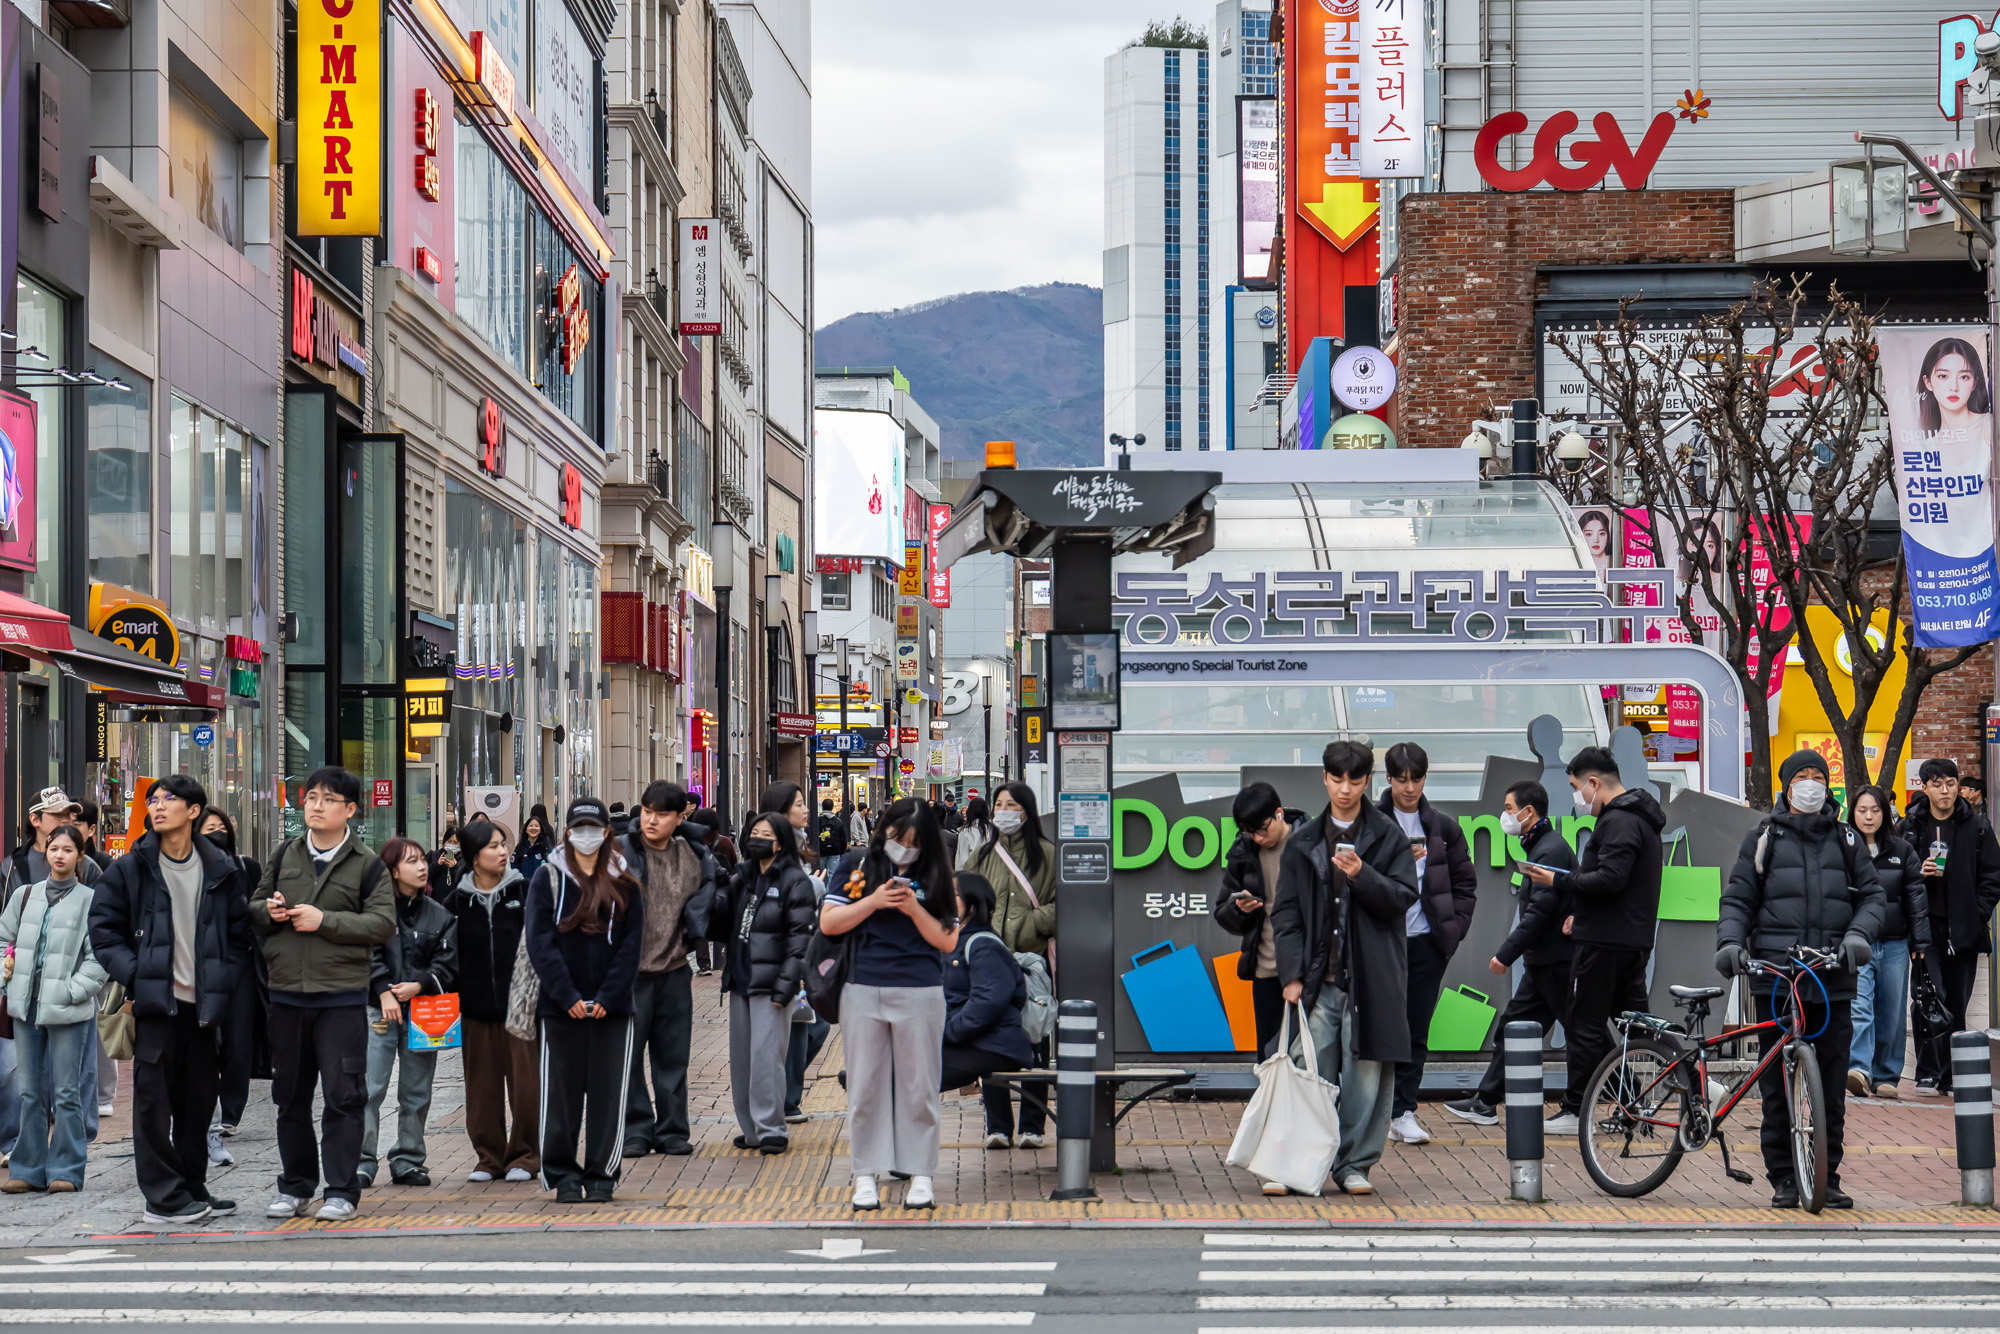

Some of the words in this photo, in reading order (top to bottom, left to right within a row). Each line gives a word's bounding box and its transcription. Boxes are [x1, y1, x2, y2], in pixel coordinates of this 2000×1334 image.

[1474, 110, 1676, 192] CGV
[1384, 159, 1400, 170] 2F
[695, 245, 706, 257] 엠
[695, 261, 707, 311] 성형외과
[694, 312, 706, 320] 의원
[1346, 386, 1367, 394] 푸라닭
[1369, 386, 1383, 394] 치킨
[1560, 384, 1585, 394] NOW
[1941, 428, 1968, 443] 진료
[1903, 450, 1942, 472] 로앤
[1906, 474, 1983, 498] 산부인과
[1115, 493, 1144, 513] 중구
[1908, 502, 1949, 524] 의원
[904, 550, 919, 592] 부동산
[934, 589, 946, 598] 3F
[1916, 585, 1992, 608] 053.710.8488
[1112, 568, 1679, 646] 동성로관광특구
[112, 620, 159, 635] emart
[1955, 619, 1971, 630] 한일
[1975, 608, 1991, 629] 4F
[899, 660, 917, 669] 노래
[1118, 660, 1190, 674] ongseongno
[1192, 659, 1234, 673] Special
[1236, 660, 1276, 671] Tourist
[1278, 660, 1308, 671] Zone
[410, 697, 443, 716] 커피
[1624, 705, 1659, 715] ANGO
[196, 731, 211, 740] ADT
[1143, 892, 1210, 918] 동성로
